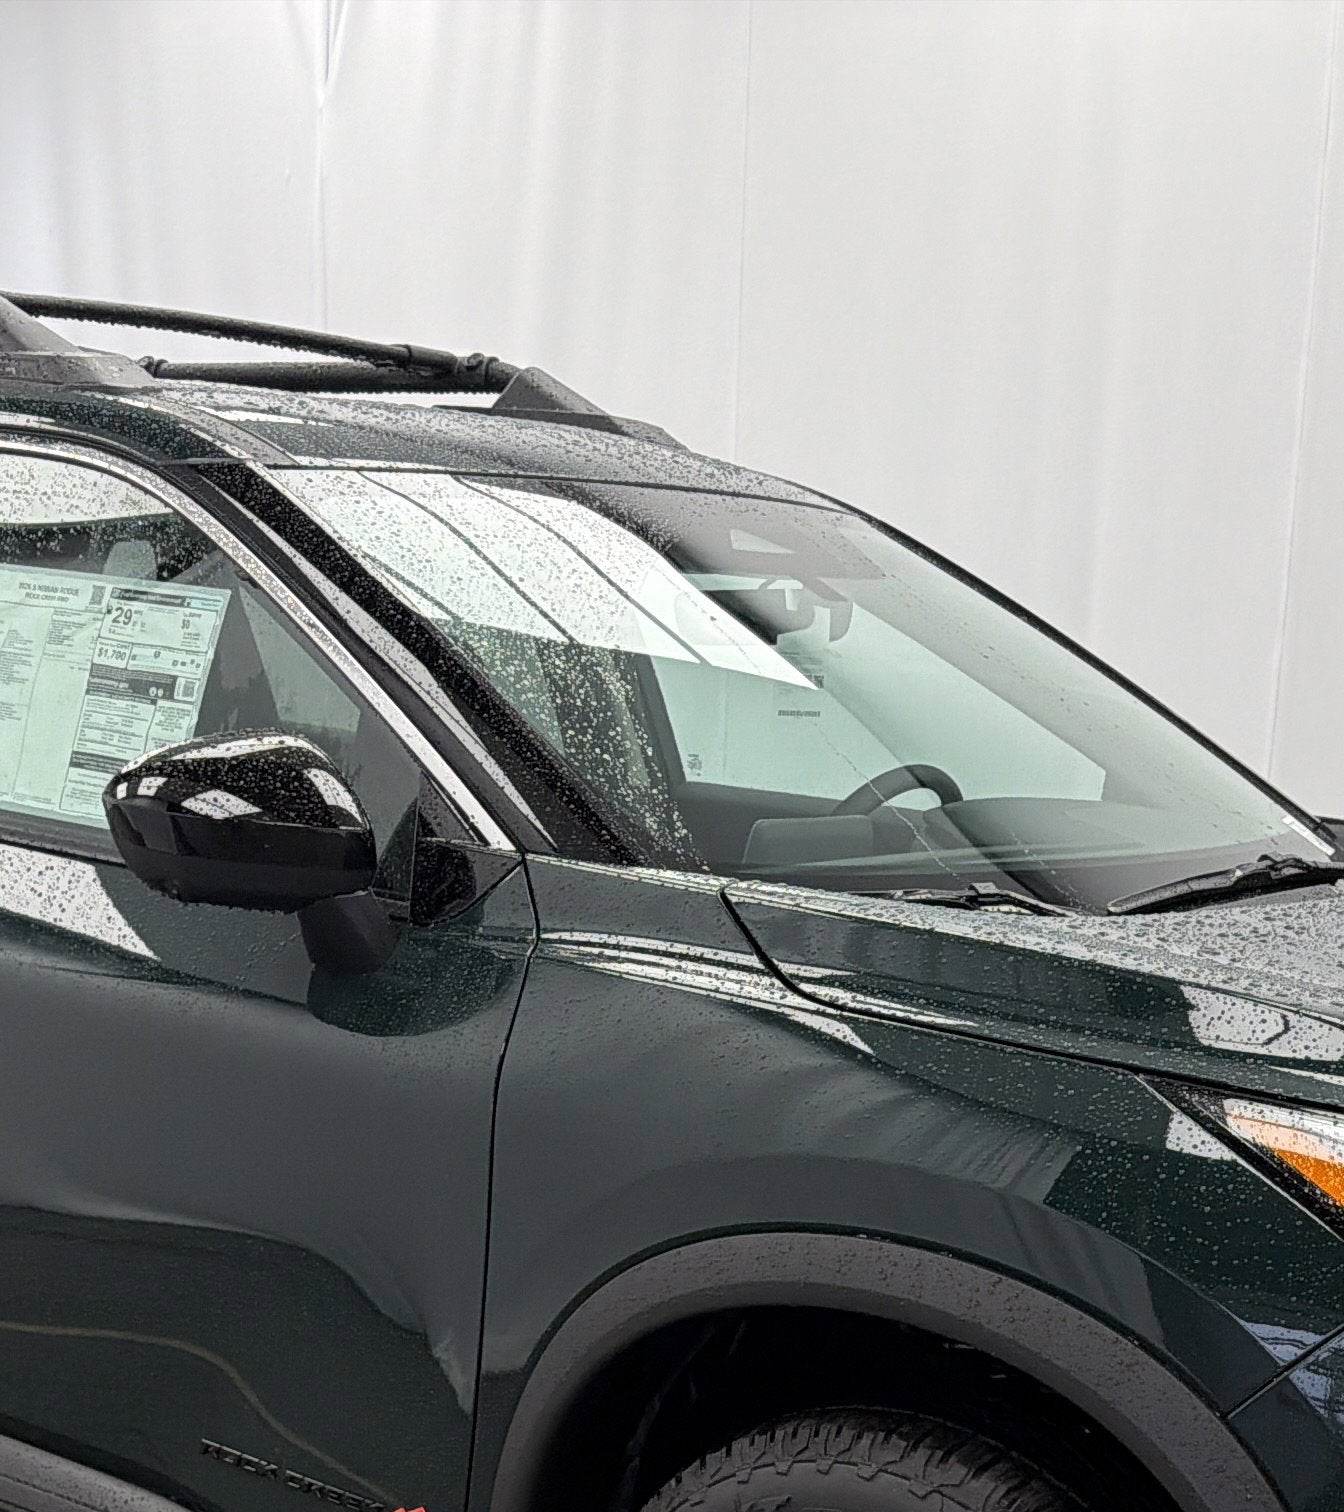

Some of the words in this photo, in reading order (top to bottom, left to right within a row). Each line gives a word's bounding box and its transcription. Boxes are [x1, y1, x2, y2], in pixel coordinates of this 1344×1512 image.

[111, 606, 133, 626] 29
[97, 646, 127, 661] $1,700
[201, 1438, 278, 1481] ROCK
